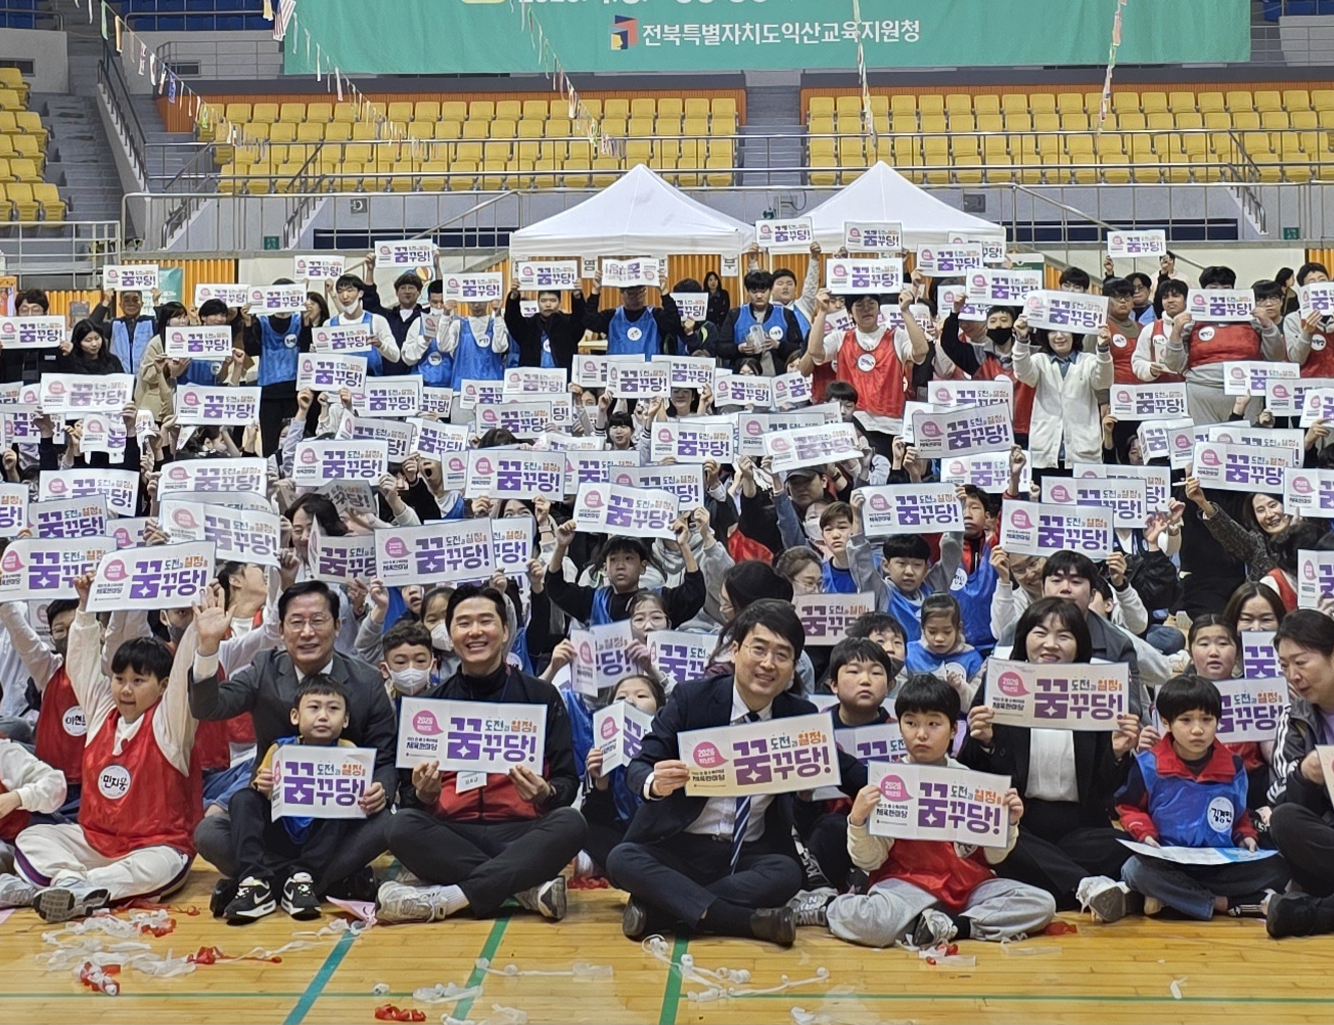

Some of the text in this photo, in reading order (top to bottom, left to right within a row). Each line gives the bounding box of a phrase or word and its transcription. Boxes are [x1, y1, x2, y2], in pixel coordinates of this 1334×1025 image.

[642, 20, 920, 46] 전북특별자치도익산교육지원청
[497, 461, 559, 491] 꿈꾸당!
[895, 495, 958, 525] 꿈꾸당!
[1038, 515, 1108, 550] 꿈꾸당!
[415, 538, 490, 574] 꿈꾸당!
[129, 560, 207, 599] 꿈꾸당!
[1034, 678, 1123, 720] 꿈꾸당!
[447, 717, 536, 762] 꿈꾸당!
[733, 737, 831, 786] 꿈꾸당!
[284, 761, 366, 807] 꿈꾸당!
[917, 782, 1001, 835] 꿈꾸당!
